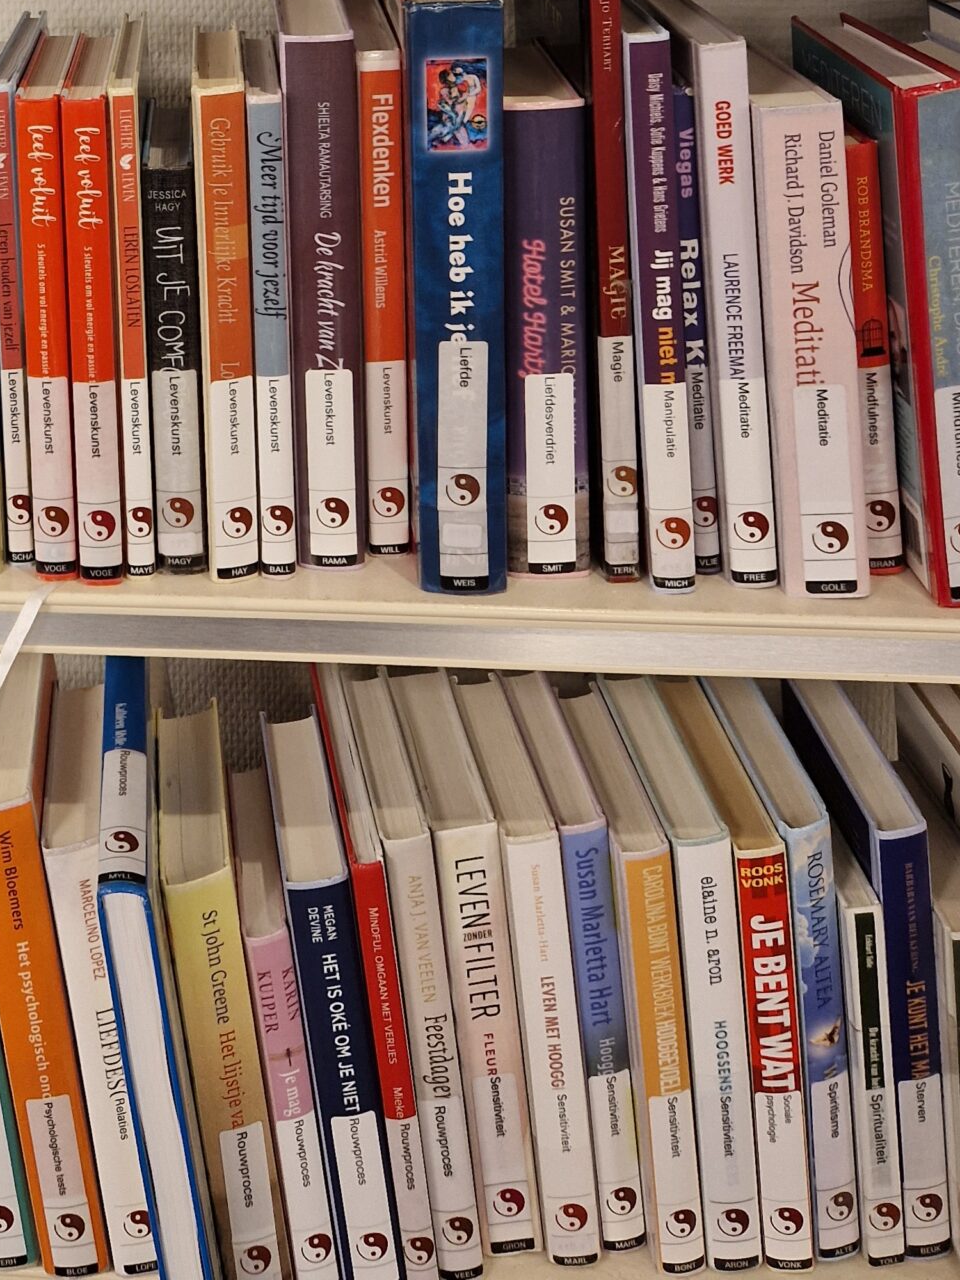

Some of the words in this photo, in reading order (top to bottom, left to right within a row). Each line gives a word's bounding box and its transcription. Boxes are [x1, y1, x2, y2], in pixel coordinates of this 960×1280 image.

[714, 100, 732, 138] GOED
[27, 125, 54, 167] leef
[256, 131, 279, 190] Meer
[372, 93, 395, 208] Flexdenken
[717, 142, 735, 185] WERK
[819, 131, 837, 175] Daniel
[30, 167, 57, 229] voluit
[147, 189, 187, 200] JESSICA
[155, 202, 180, 212] HAGY
[254, 194, 283, 226] tijd
[448, 172, 473, 227] Hoe
[820, 179, 839, 248] Goleman
[262, 229, 280, 266] voor
[449, 235, 475, 283] heb
[156, 273, 190, 302] JE
[254, 270, 287, 319] jezelf
[450, 290, 475, 316] ik
[459, 347, 472, 388] Liefde
[611, 341, 623, 383] Magie
[8, 371, 21, 444] Levenskunst
[229, 381, 240, 455] Levenskunst
[323, 373, 335, 446] Levenskunst
[544, 377, 555, 465] Liefdesverdriet
[664, 390, 675, 458] Manipulatie
[816, 389, 831, 447] Meditatie
[865, 373, 880, 445] Mindfulness
[322, 556, 347, 565] RAMA
[821, 583, 846, 592] GOLE
[455, 856, 491, 928] LEVEN
[740, 863, 783, 877] ROOS
[741, 876, 784, 888] VONK
[4, 867, 23, 931] Bloemers
[202, 910, 218, 928] St
[323, 905, 337, 940] MEGAN
[201, 928, 221, 967] John
[308, 907, 323, 943] DEVINE
[463, 929, 493, 941] ZONDER
[750, 915, 784, 949] JE
[211, 970, 228, 1025] Greene
[464, 943, 500, 1020] FILTER
[753, 954, 791, 1026] BENT
[758, 1031, 795, 1091] WAT
[115, 1098, 128, 1141] Relaties
[434, 1106, 453, 1177] Rouwproces
[557, 1094, 570, 1153] Sensitiviteit
[719, 1096, 734, 1158] Sensitiviteit
[871, 1094, 887, 1165] Spiritualiteit
[236, 1132, 253, 1208] Rouwproces
